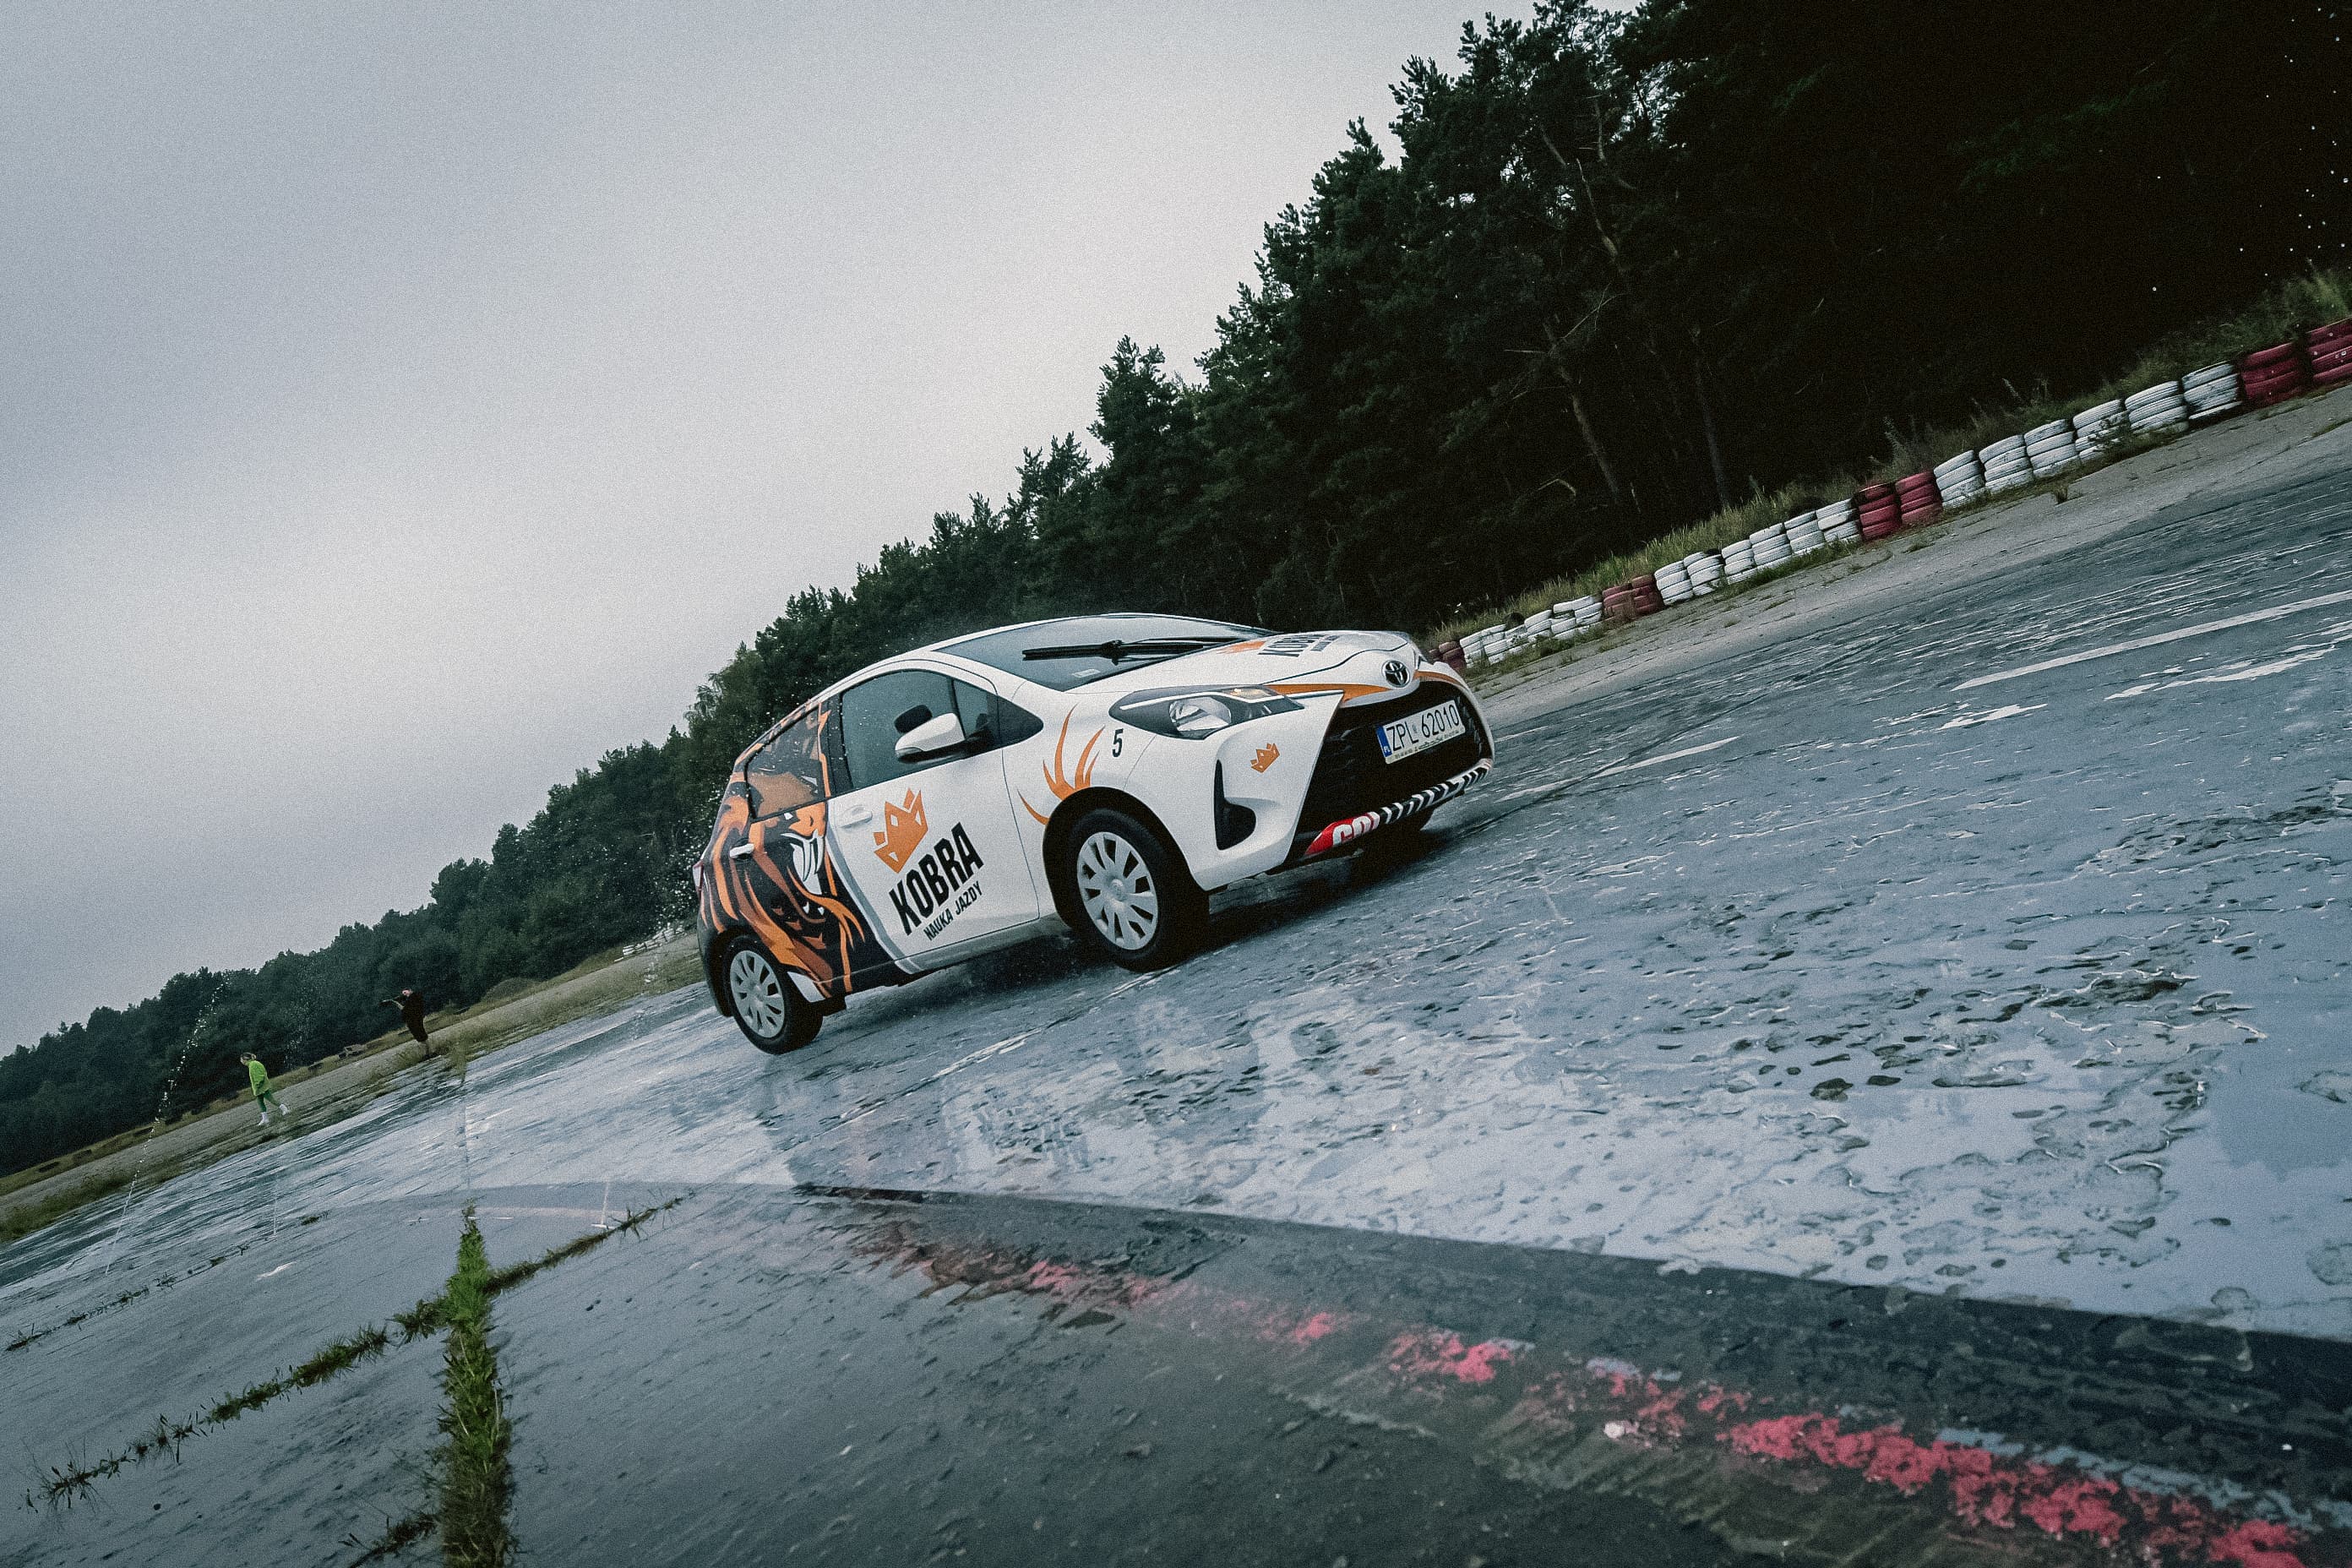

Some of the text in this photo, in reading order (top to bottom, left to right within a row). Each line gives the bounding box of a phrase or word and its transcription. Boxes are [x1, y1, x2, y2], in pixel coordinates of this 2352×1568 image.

[1112, 728, 1124, 758] 5
[1386, 721, 1419, 751] ZPL
[1421, 704, 1460, 738] 62010
[888, 821, 985, 936] KOBRA
[923, 880, 983, 941] NAUKA JAZDY
